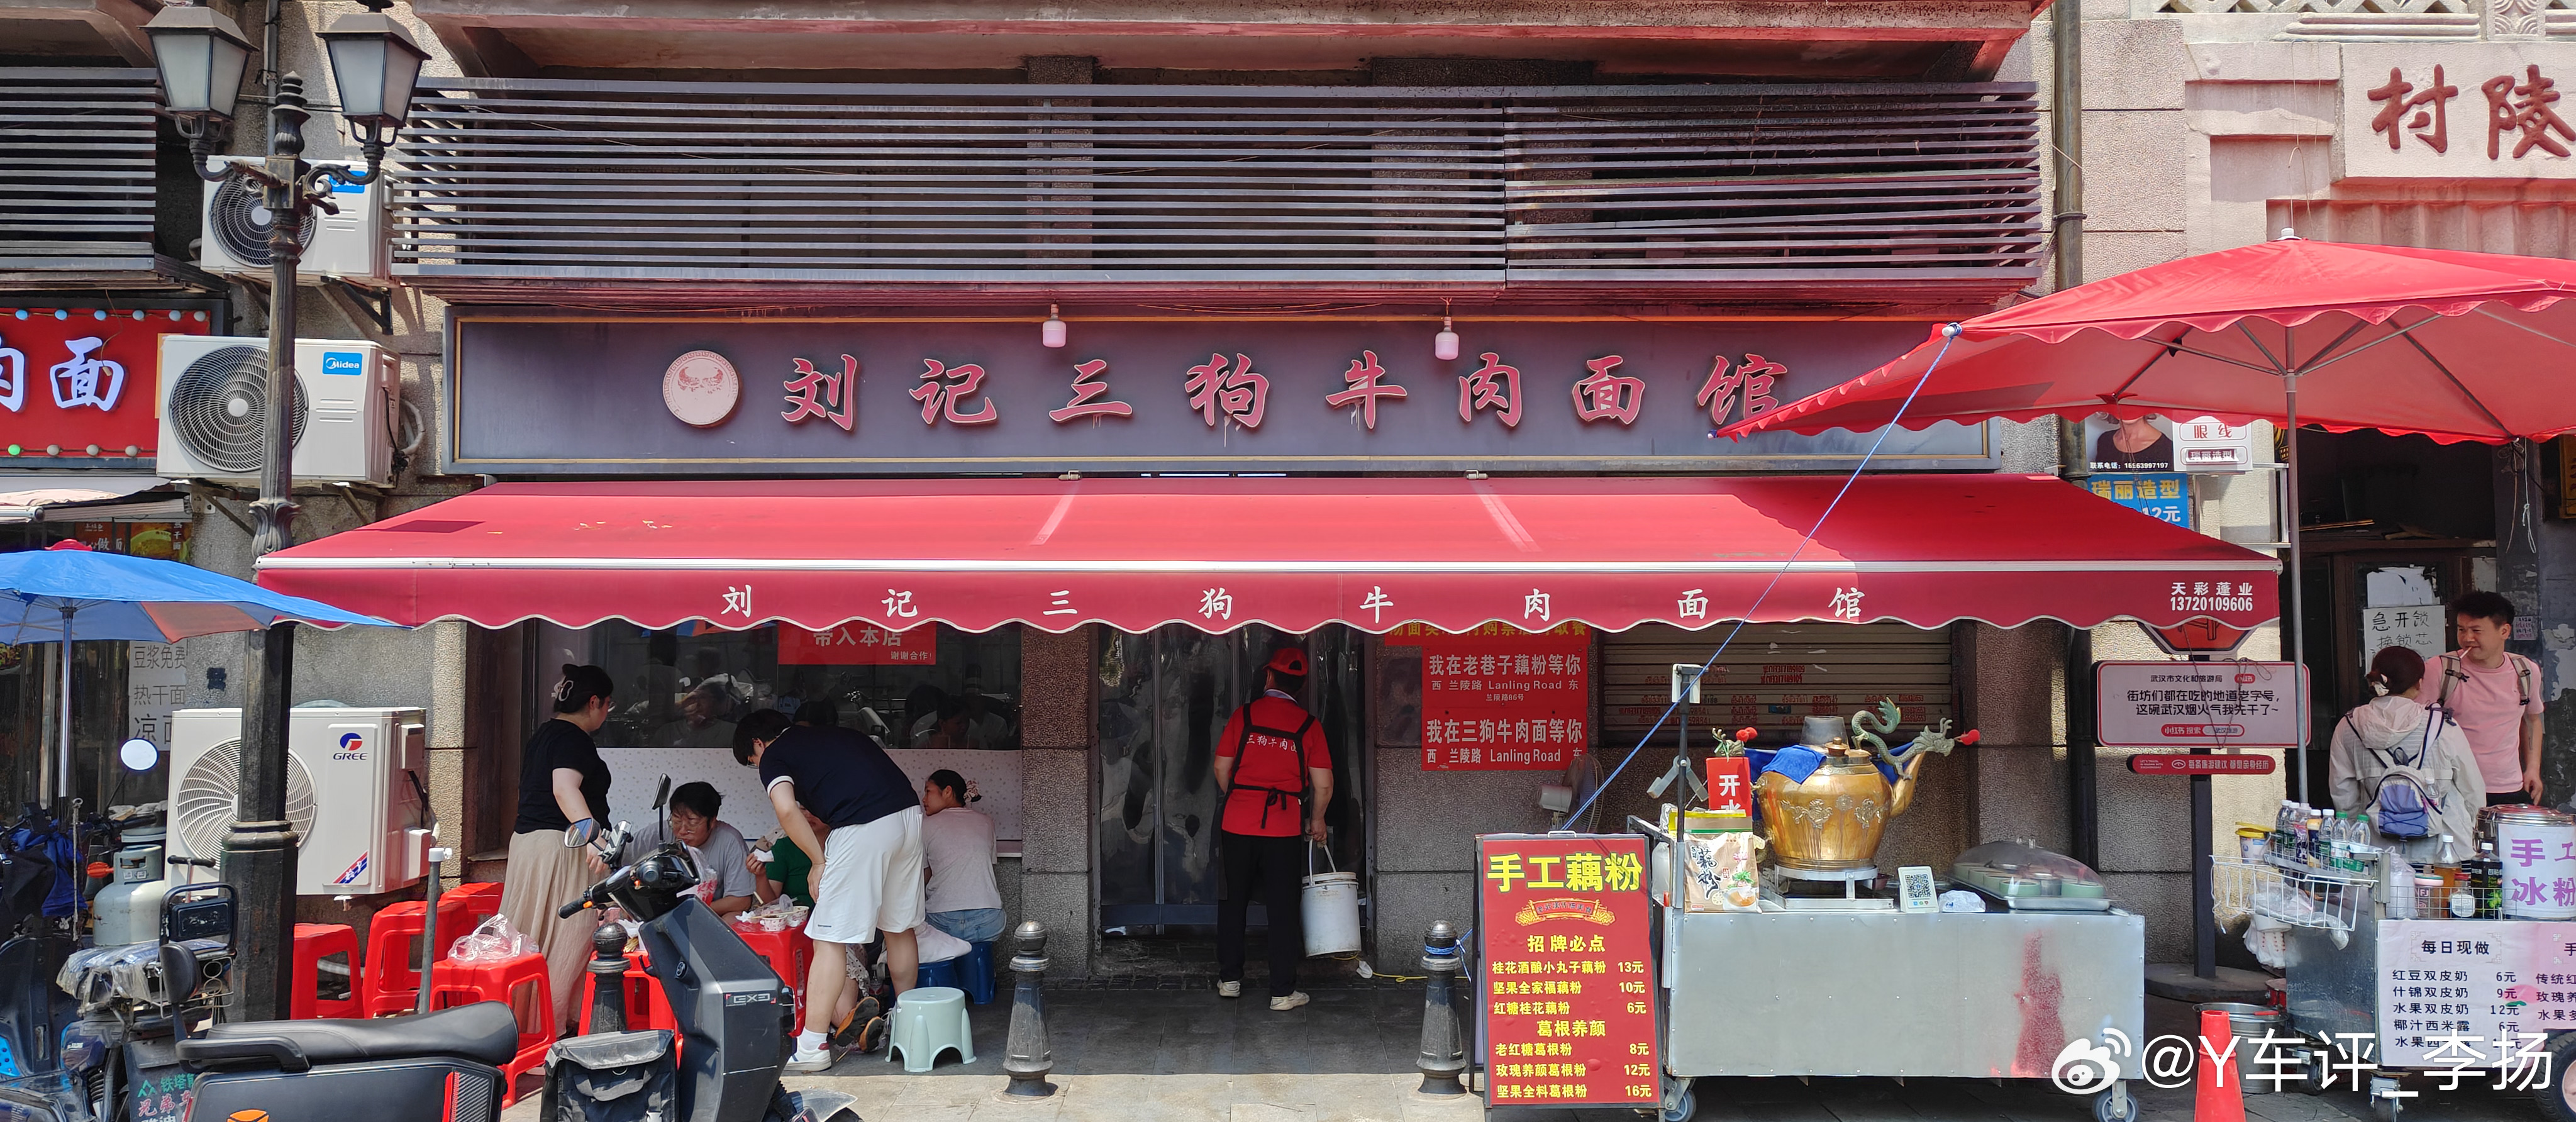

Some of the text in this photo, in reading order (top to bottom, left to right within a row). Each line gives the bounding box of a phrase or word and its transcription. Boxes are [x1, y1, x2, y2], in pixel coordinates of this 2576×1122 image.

[326, 357, 360, 369] Midea
[781, 350, 1787, 431] 刘记三狗牛肉面馆
[2194, 425, 2232, 438] 眼线
[2091, 480, 2180, 500] 瑞丽造型
[721, 585, 1865, 622] 刘记三狗牛肉面馆
[2170, 597, 2253, 611] 13720109606
[133, 645, 187, 669] 豆浆免费
[1429, 654, 1582, 676] 我在老巷子藕粉等你
[1431, 679, 1579, 691] 西 兰陵路 Lanling Road 东
[134, 684, 186, 706] 热干面
[1426, 718, 1584, 744] 我在三狗牛肉面等你
[1426, 749, 1437, 764] 西
[1448, 748, 1482, 764] 兰陵路
[1490, 749, 1530, 765] Lanling
[1533, 748, 1561, 762] Road
[2511, 838, 2576, 867] 手工
[1486, 852, 1643, 893] 手工藕粉
[2511, 876, 2576, 907] 冰粉
[1528, 934, 1606, 953] 招牌必点
[2422, 940, 2490, 955] 每日现做
[1492, 960, 1645, 975] 桂花酒酿小丸子藕粉 13元
[2392, 969, 2517, 982] 红豆双皮奶 6元
[2536, 974, 2576, 984] 传统红
[1493, 980, 1646, 995] 坚果全家福藕粉 10元
[2393, 986, 2518, 999] 什锦双皮奶 9元
[1494, 1001, 1647, 1015] 红糖桂花藕粉 6元
[2393, 1003, 2519, 1016] 水果双皮奶 12元
[1536, 1019, 1606, 1038] 葛根养颜
[2394, 1019, 2520, 1033] 椰汁西米露 6元
[1496, 1042, 1650, 1057] 老红糖葛根粉 8元
[1496, 1064, 1651, 1078] 玫瑰养颜葛根粉 12元
[1497, 1084, 1652, 1099] 坚果全料葛根粉 16元
